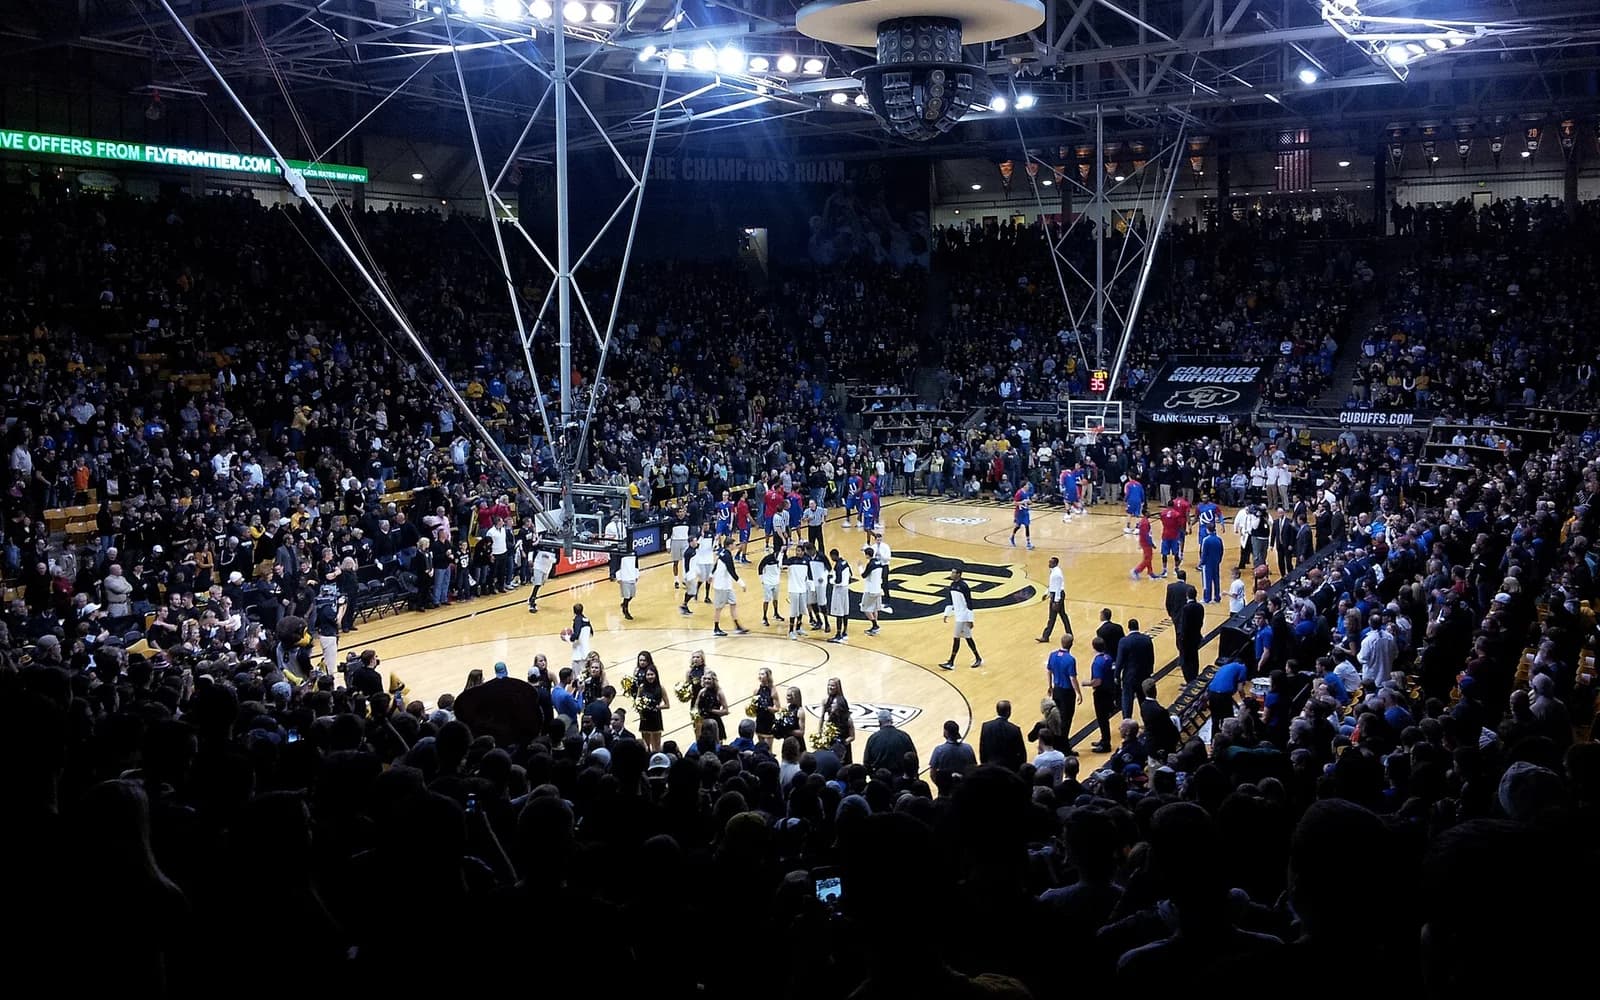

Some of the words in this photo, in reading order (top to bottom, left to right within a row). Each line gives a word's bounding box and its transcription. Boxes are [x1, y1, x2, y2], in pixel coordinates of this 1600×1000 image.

[28, 134, 93, 156] OFFERS
[97, 141, 140, 160] FROM
[145, 145, 271, 173] FLYFRONTIER.COM
[348, 173, 366, 182] APPLY
[1173, 366, 1260, 375] COLORADO
[1091, 378, 1105, 391] 35
[1167, 374, 1256, 383] BUFFALOES
[1152, 413, 1179, 423] BANK
[1188, 415, 1215, 424] WEST
[1340, 411, 1414, 425] CUBUFFS.COM
[632, 533, 654, 551] pepsi
